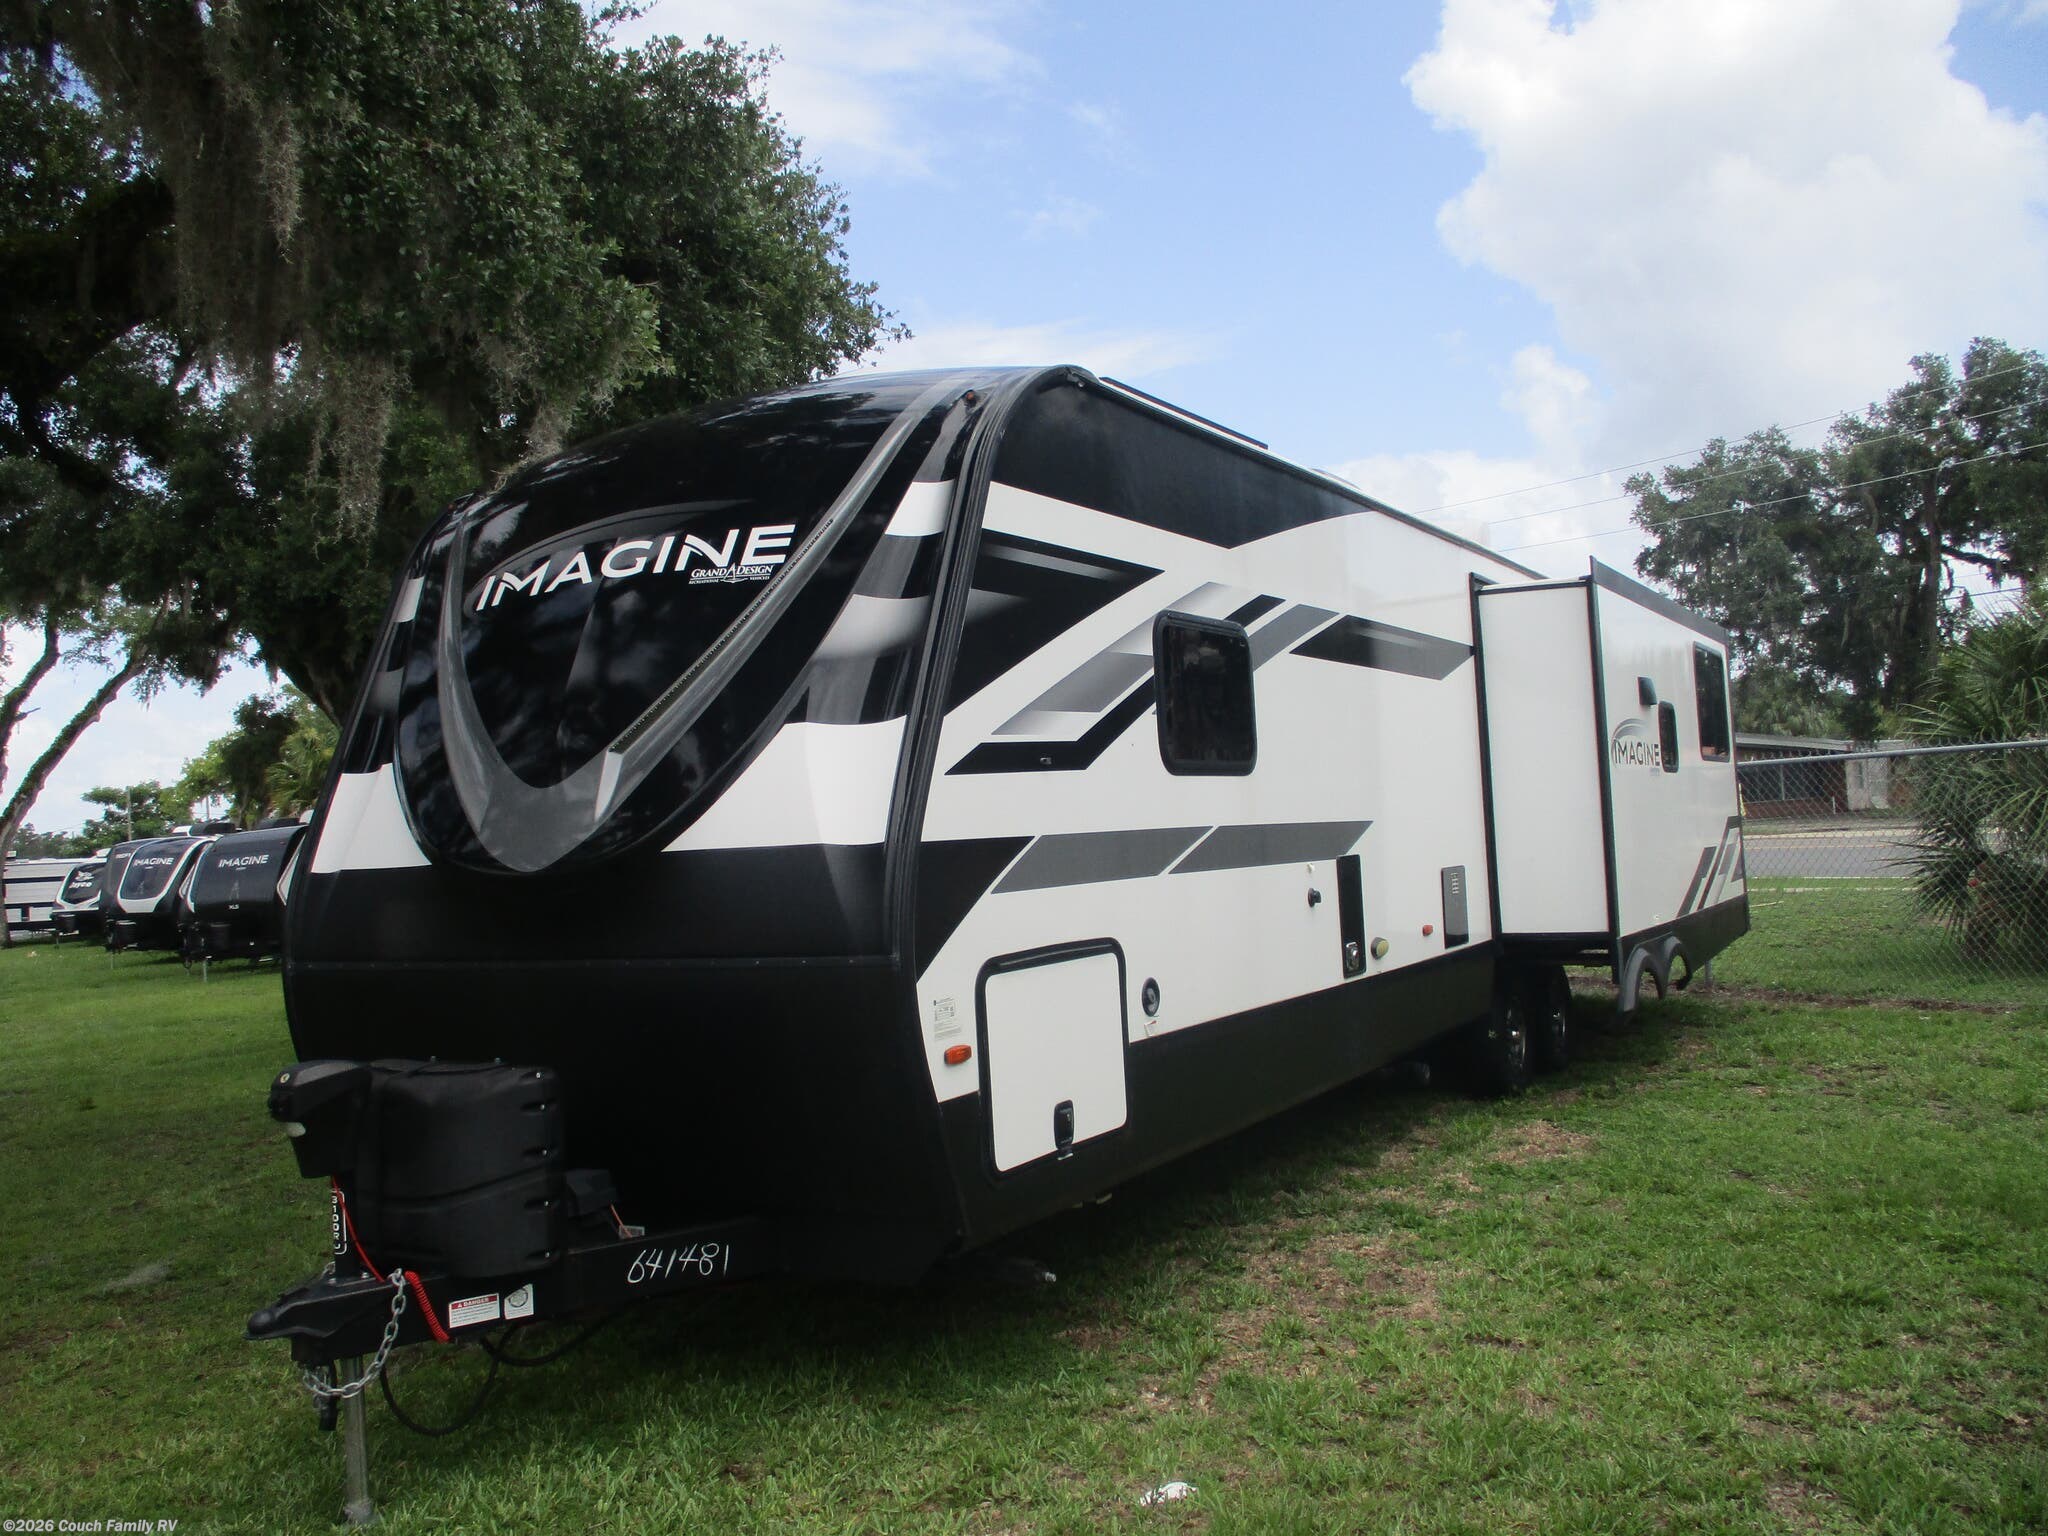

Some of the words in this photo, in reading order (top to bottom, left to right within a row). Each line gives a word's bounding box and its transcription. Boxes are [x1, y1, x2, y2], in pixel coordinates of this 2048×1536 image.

[475, 524, 796, 612] IMAGINE
[691, 568, 727, 578] GRAND
[736, 565, 774, 575] DESIGN
[1613, 738, 1661, 767] IMAGINE
[133, 857, 174, 867] IMAGINE
[218, 854, 269, 868] IMAGINE
[627, 1243, 729, 1284] 641481
[463, 1297, 490, 1307] DANGER
